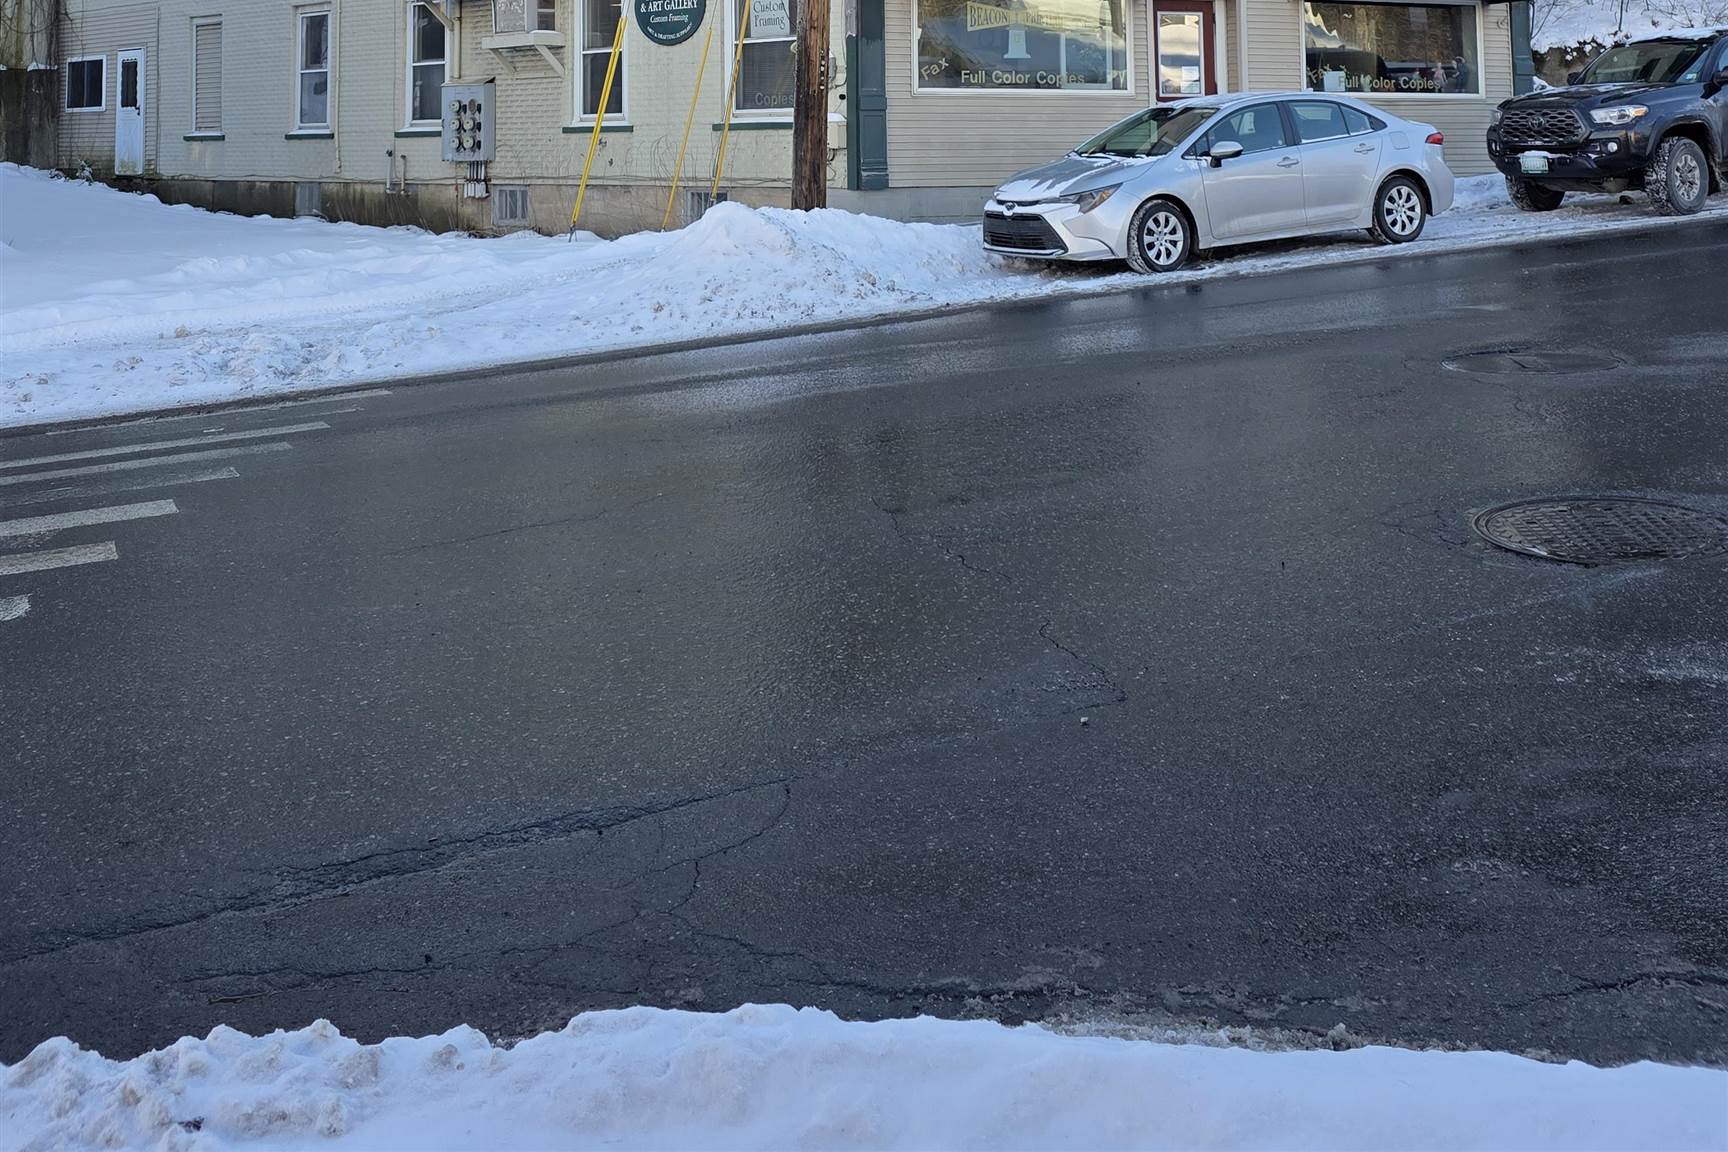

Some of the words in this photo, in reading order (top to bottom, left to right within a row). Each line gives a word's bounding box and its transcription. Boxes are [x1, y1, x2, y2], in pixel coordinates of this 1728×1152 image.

[640, 2, 647, 13] &
[648, 0, 663, 12] ART
[753, 0, 785, 13] Custom
[754, 14, 786, 30] Framing
[970, 6, 1008, 27] BEACON
[920, 57, 949, 81] Fax
[961, 70, 986, 84] Full
[992, 70, 1031, 85] Color
[1036, 70, 1085, 87] Copies
[1400, 76, 1441, 90] Copies
[755, 92, 794, 106] Copies
